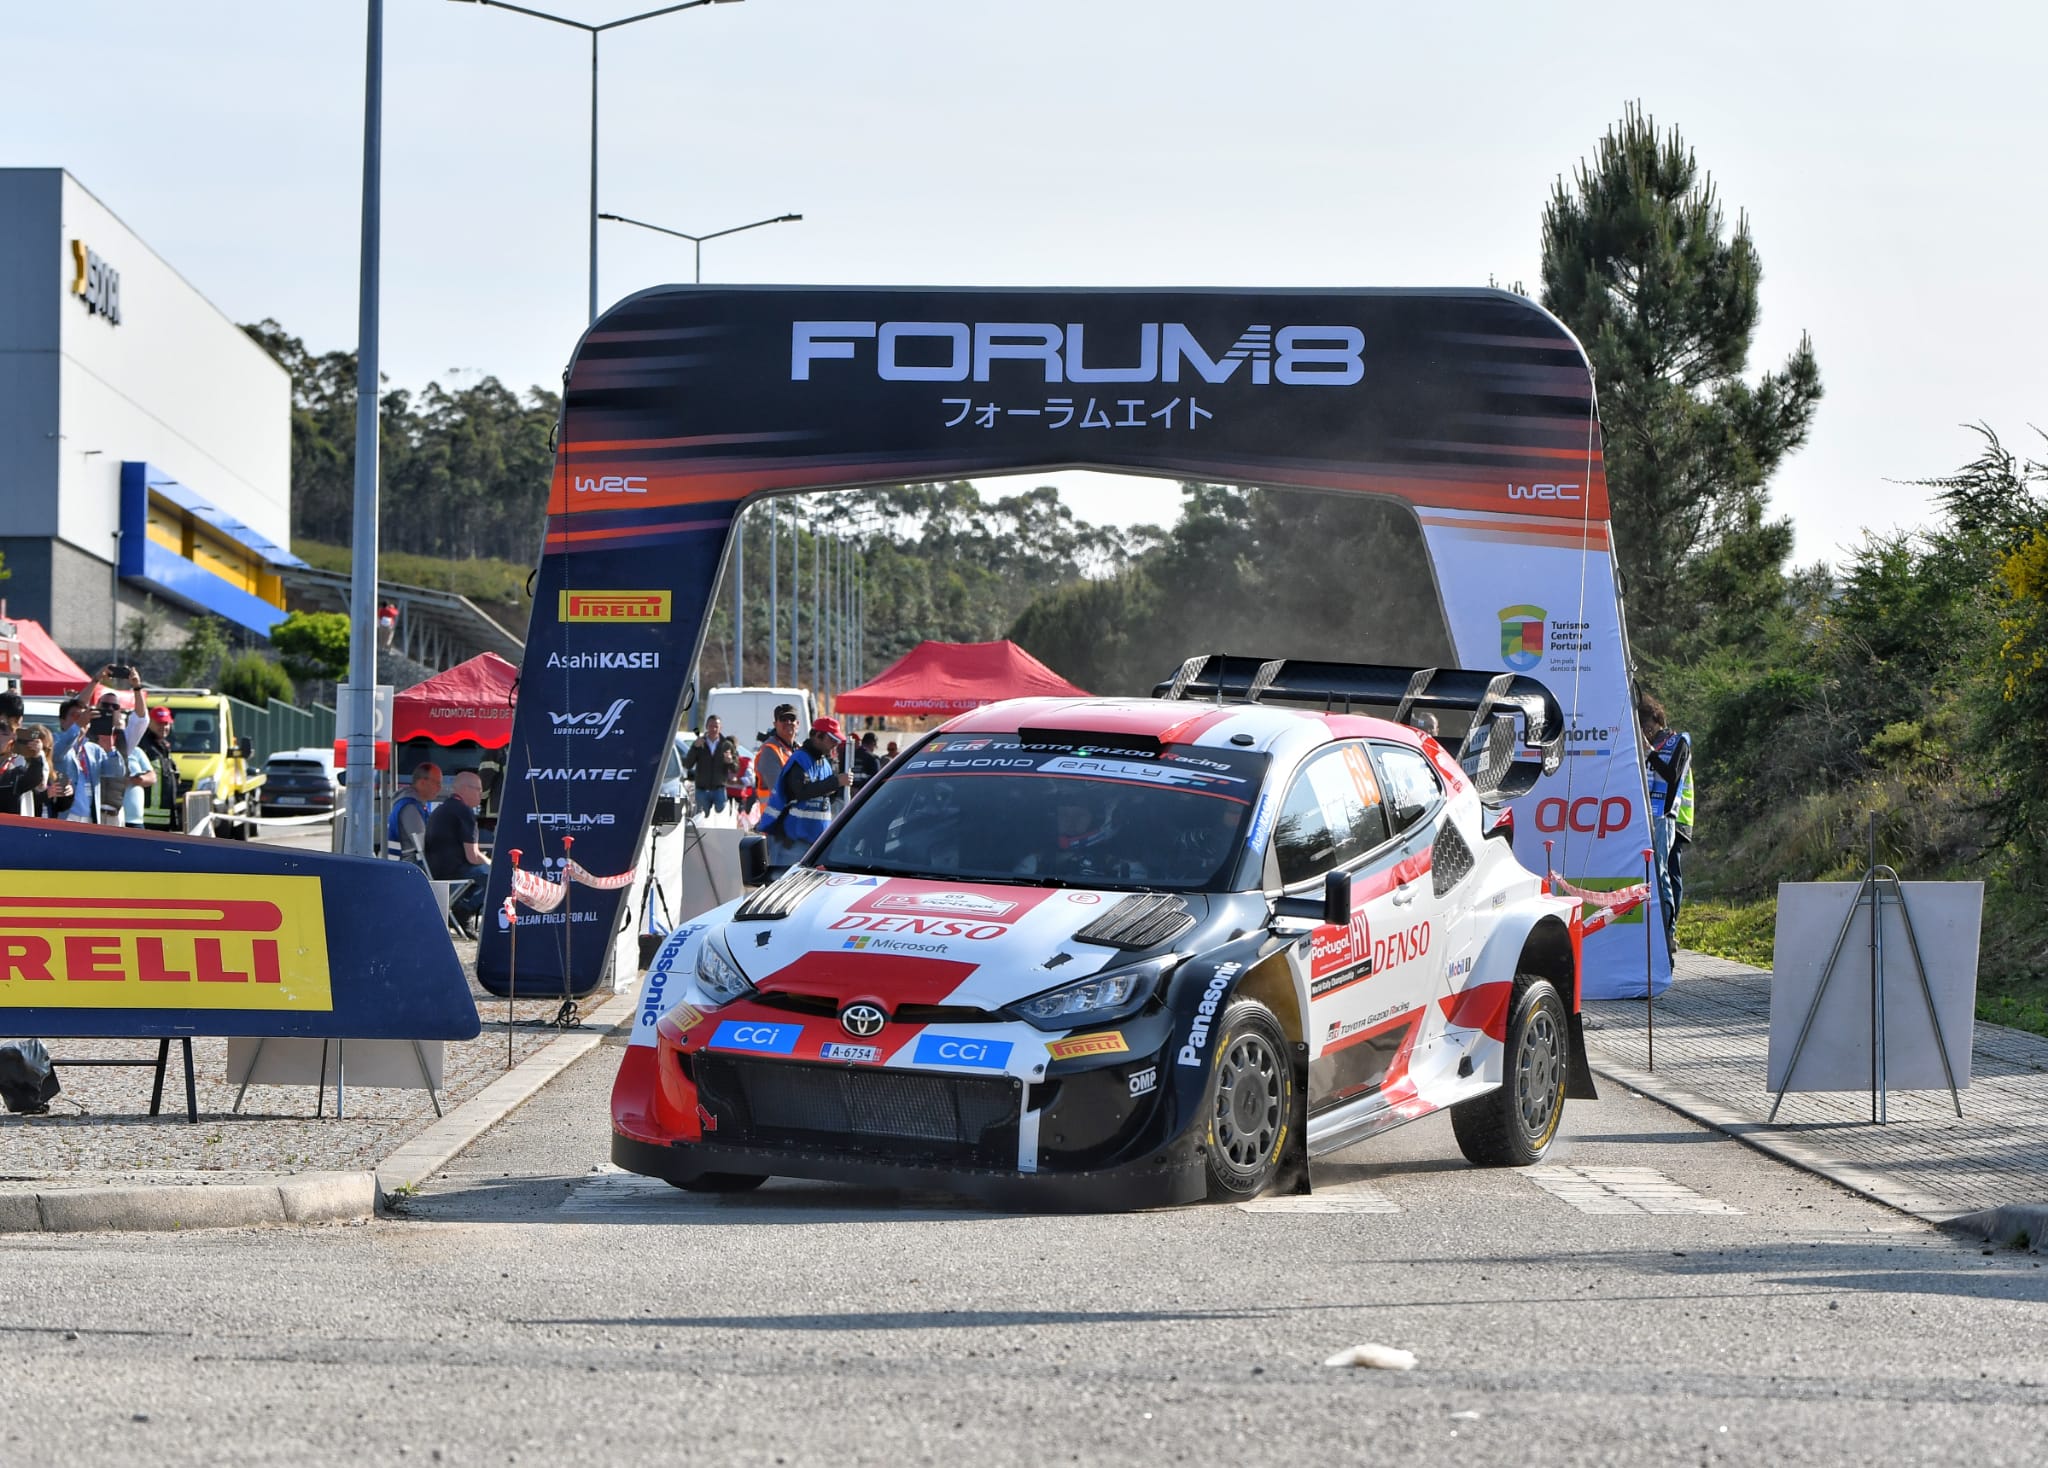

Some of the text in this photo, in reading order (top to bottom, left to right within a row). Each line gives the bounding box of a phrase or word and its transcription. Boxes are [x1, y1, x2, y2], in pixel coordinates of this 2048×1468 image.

[791, 320, 1367, 386] FORUM8
[941, 397, 1214, 430] フォーラムエイト
[575, 476, 648, 493] WRC
[1507, 483, 1581, 500] WRC
[569, 596, 662, 617] PIRELLI
[1550, 631, 1583, 640] Centro
[1551, 620, 1590, 630] Turismo
[1549, 641, 1592, 652] Portugal
[478, 708, 498, 719] CLUB
[553, 727, 599, 736] LUBRICANTS
[907, 758, 1035, 770] BEYOND
[993, 742, 1073, 750] TOYOTA
[1077, 745, 1156, 758] GAZOO
[1158, 752, 1232, 771] Racing
[525, 768, 633, 781] FANATEC
[527, 813, 616, 825] FORUM8
[1534, 796, 1633, 839] acp
[516, 914, 541, 926] CLEAN
[583, 911, 598, 922] ALL
[826, 915, 1009, 941] DENSO
[0, 897, 282, 983] RELLI
[872, 938, 949, 954] Microsoft
[1312, 933, 1350, 961] Portugal
[1372, 920, 1430, 976] DENSO
[642, 923, 709, 1027] Panasonic
[1177, 961, 1242, 1067] Panasonic
[1341, 1018, 1367, 1035] TOYOTA
[1389, 1002, 1410, 1016] Racing
[832, 1046, 871, 1059] A-6754
[1053, 1035, 1122, 1057] PIRELLI
[1129, 1069, 1157, 1093] OMP
